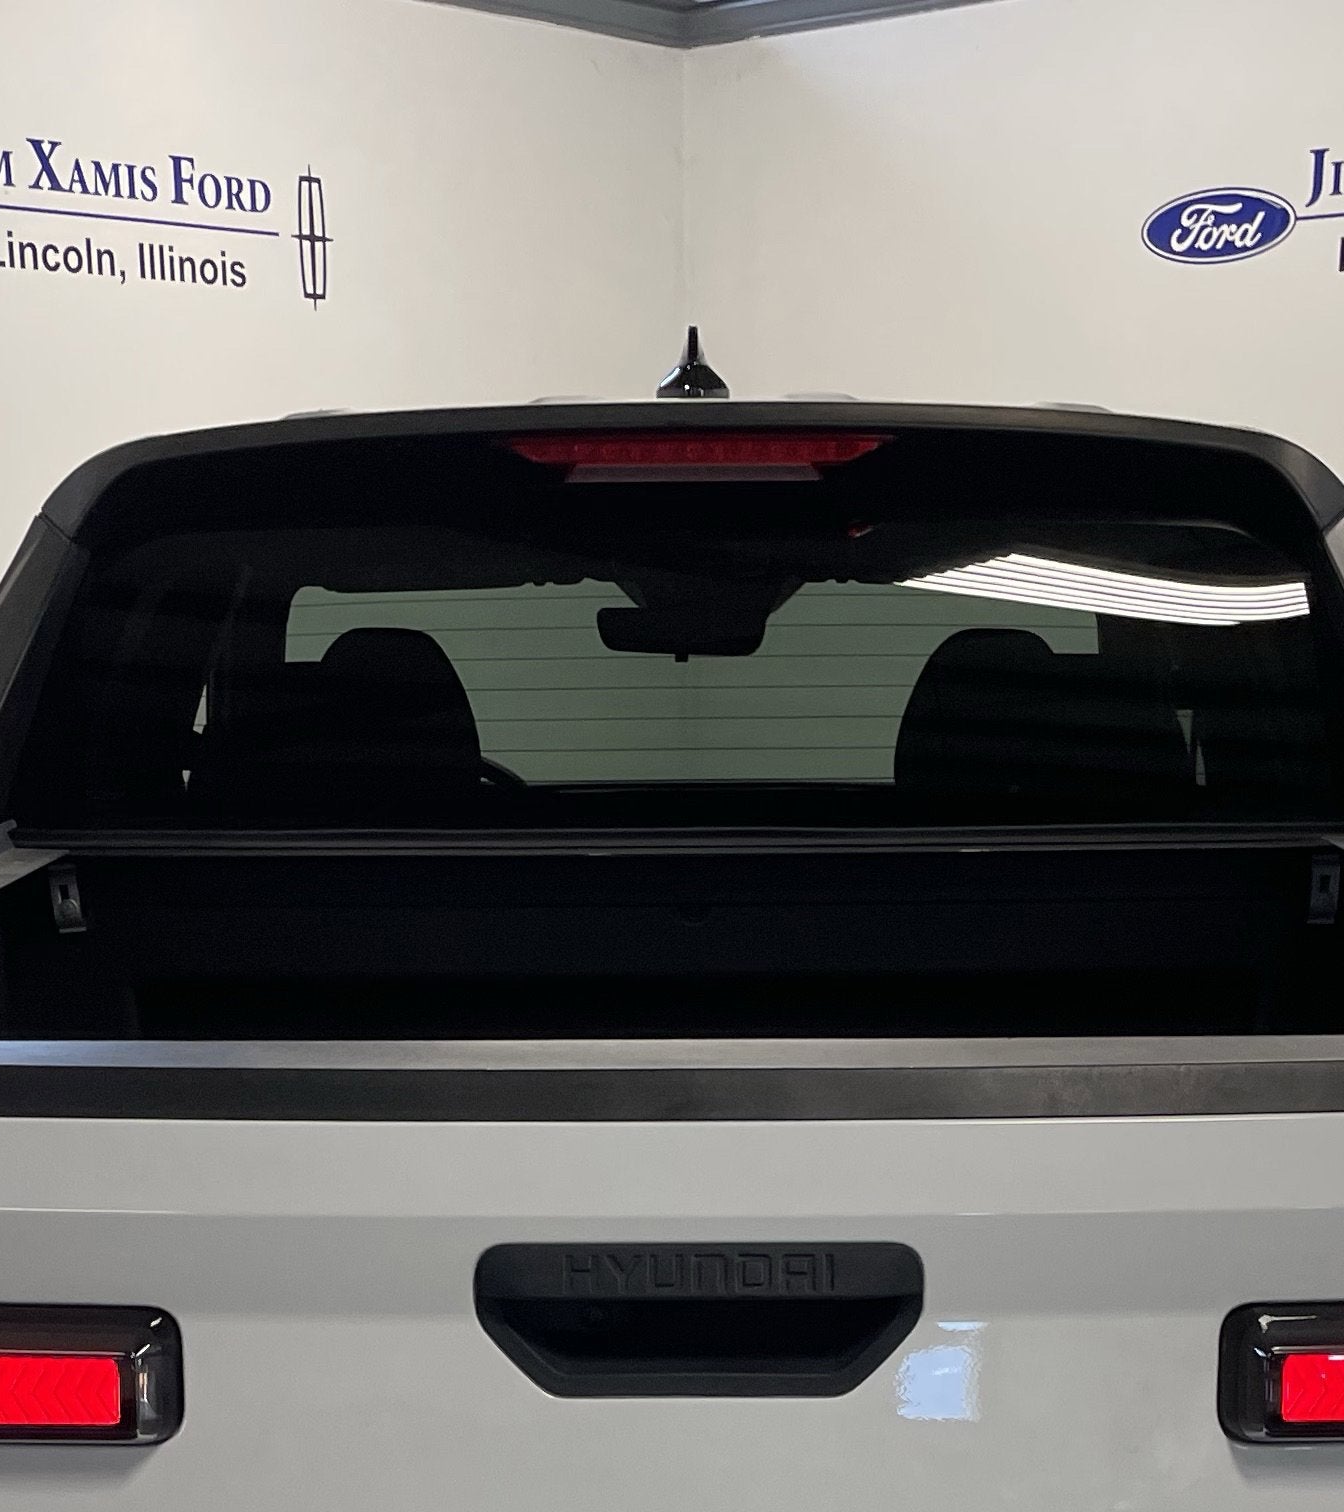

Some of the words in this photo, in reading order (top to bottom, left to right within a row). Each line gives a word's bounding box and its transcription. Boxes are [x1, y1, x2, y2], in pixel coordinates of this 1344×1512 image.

[1169, 202, 1266, 252] Ford
[138, 243, 248, 289] Illinois
[561, 1252, 836, 1293] HYUNDAI
